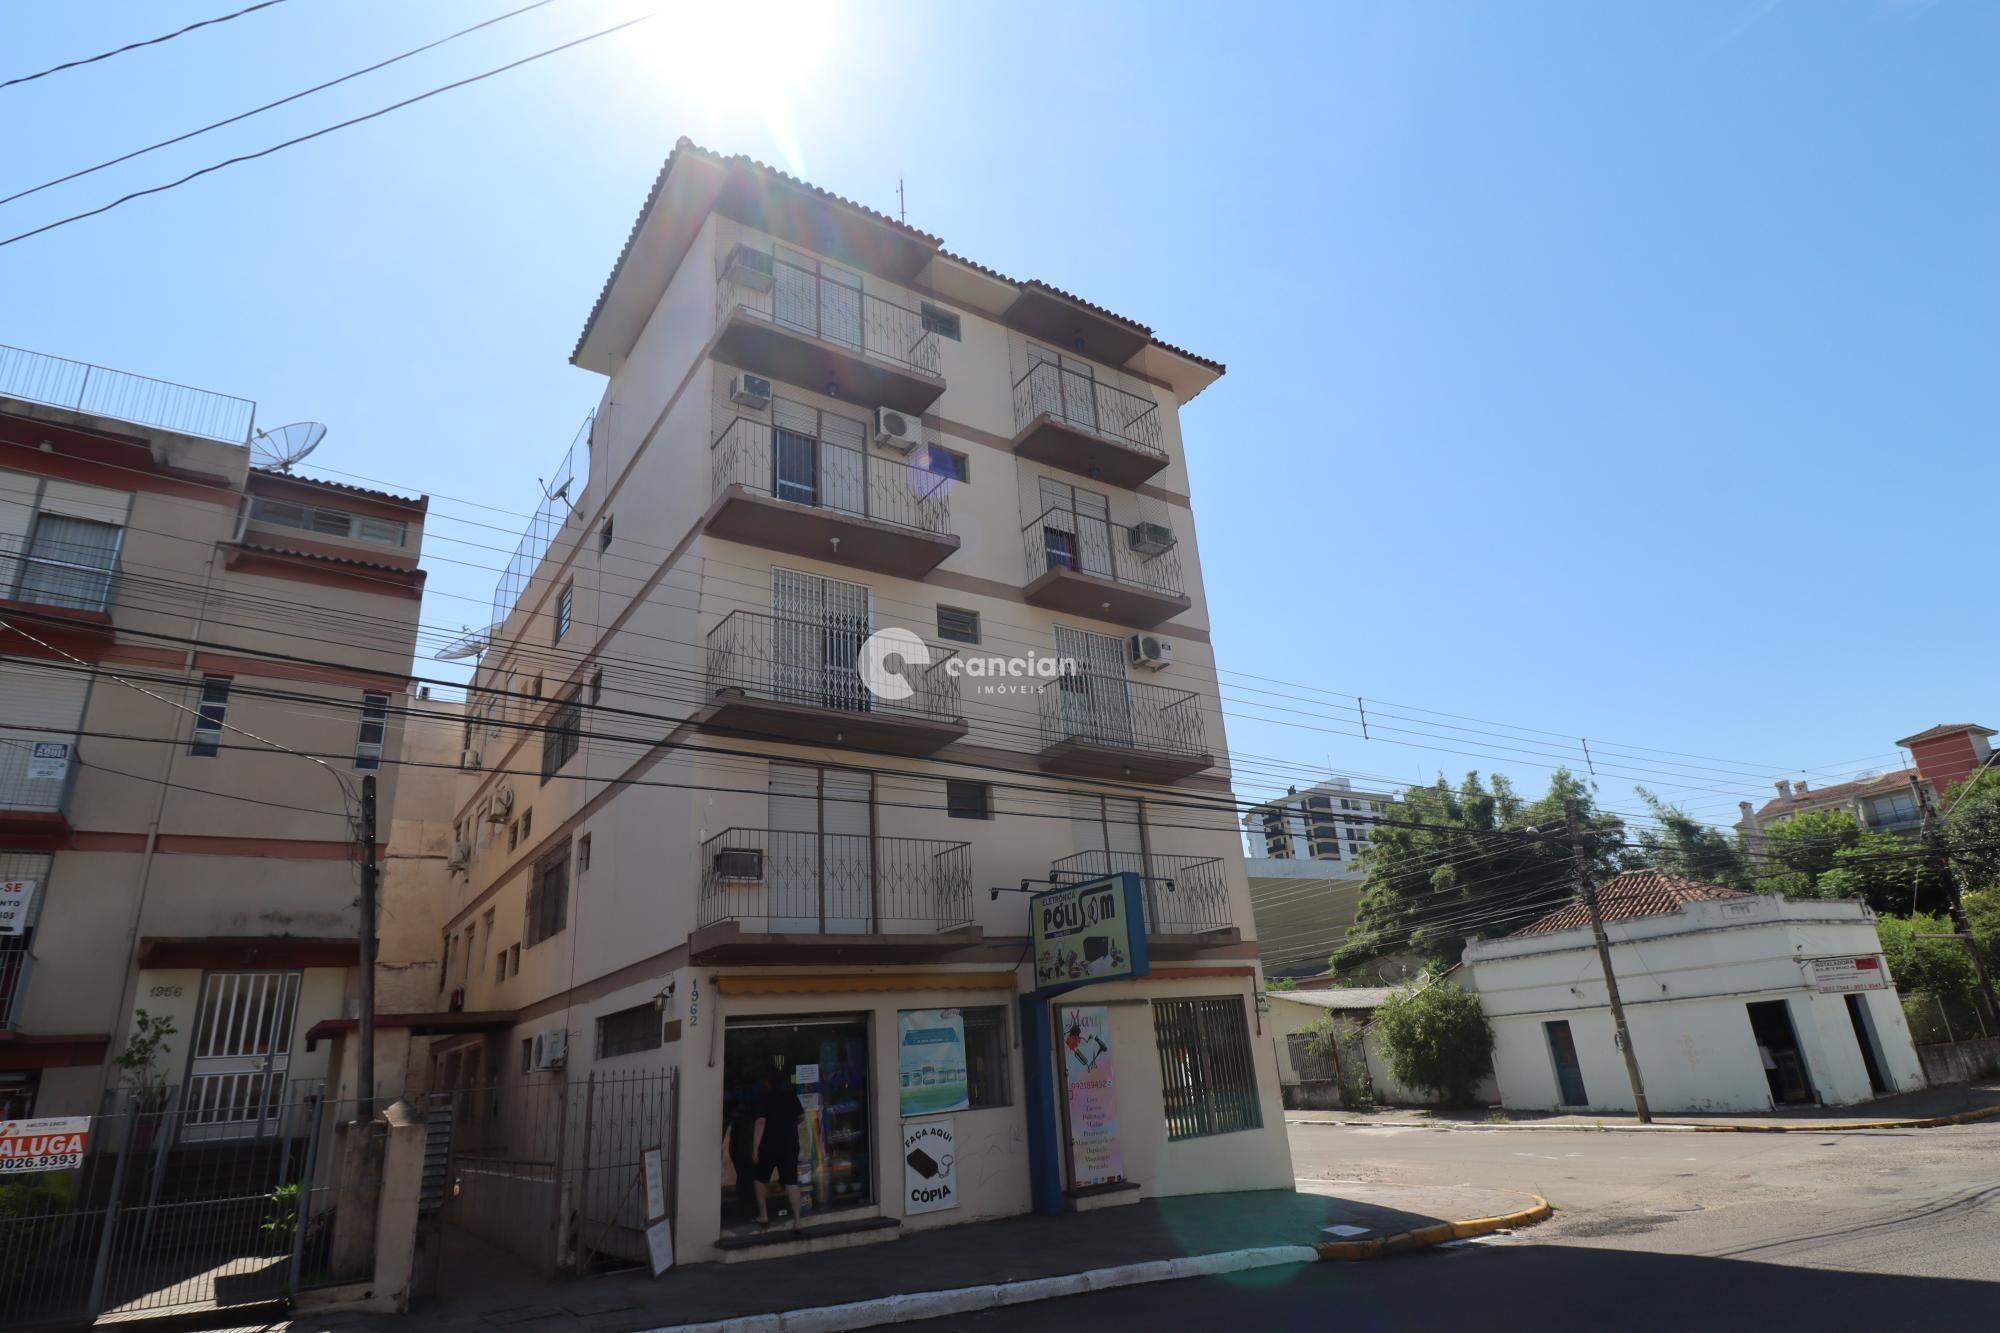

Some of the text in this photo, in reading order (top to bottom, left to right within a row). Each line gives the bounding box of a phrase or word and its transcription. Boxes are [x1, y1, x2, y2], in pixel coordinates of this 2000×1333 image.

[691, 977, 699, 1026] 1962
[930, 1127, 953, 1143] AQUI
[911, 1185, 951, 1203] CÓPIA
